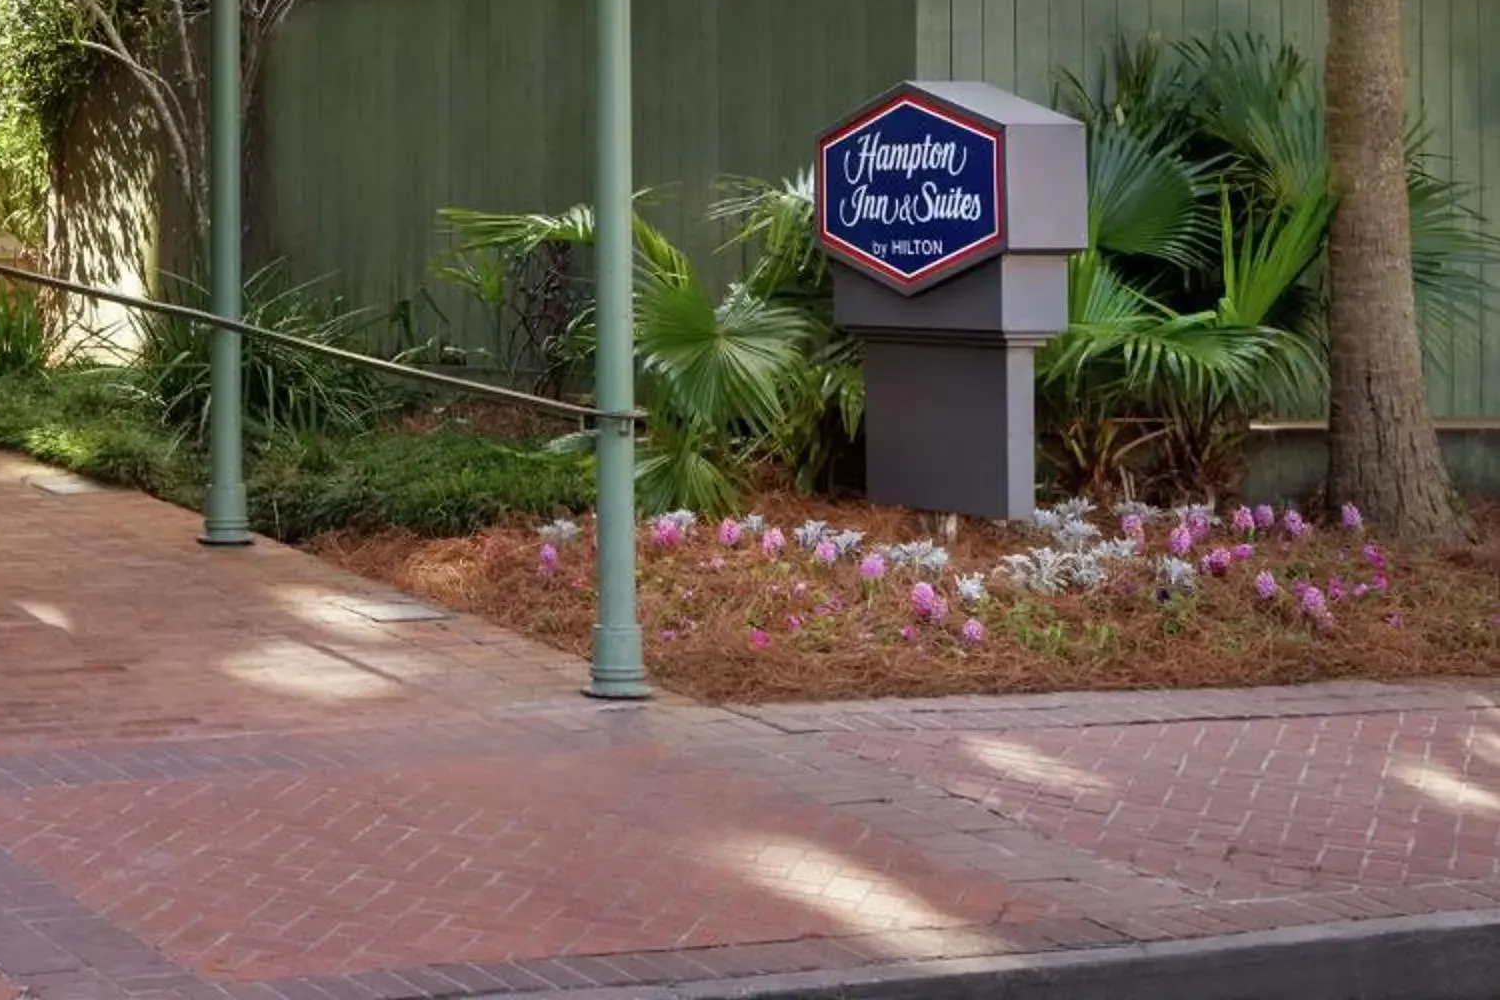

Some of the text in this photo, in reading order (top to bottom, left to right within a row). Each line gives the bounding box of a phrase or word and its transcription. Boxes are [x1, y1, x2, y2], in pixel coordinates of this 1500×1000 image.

[843, 131, 968, 185] Hampton
[839, 181, 982, 227] Inn & Suites
[871, 239, 944, 258] by HILTON
